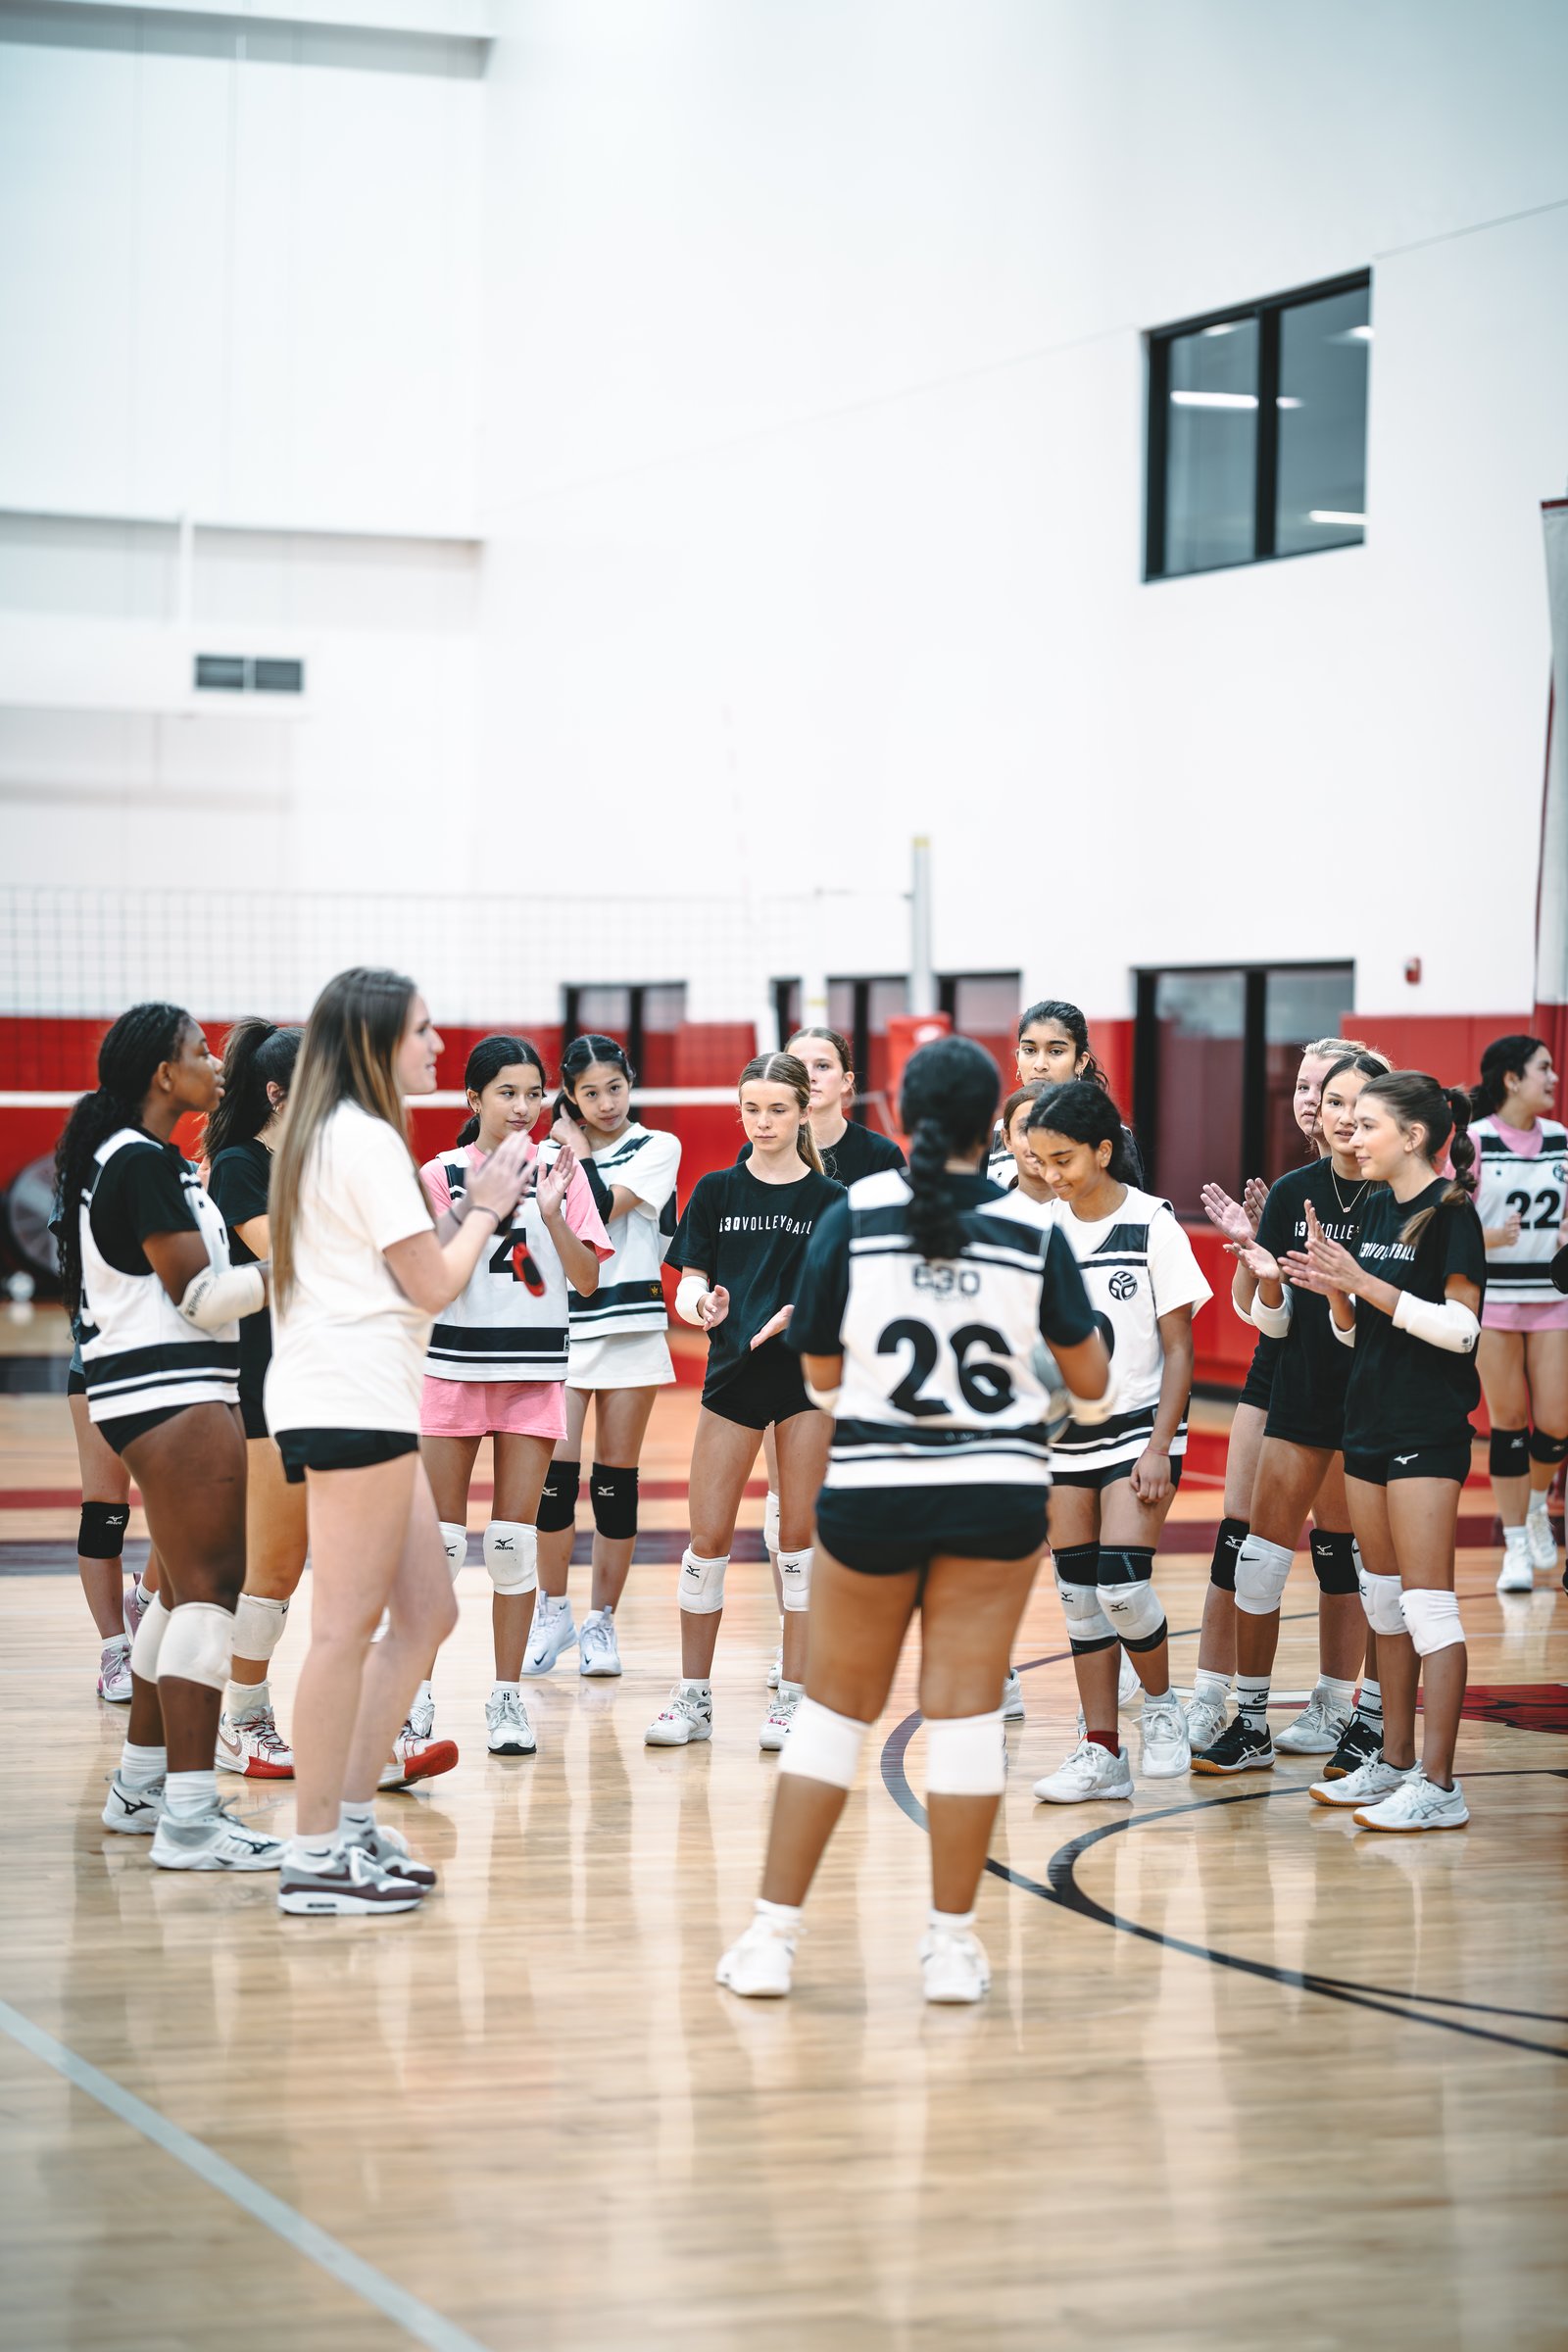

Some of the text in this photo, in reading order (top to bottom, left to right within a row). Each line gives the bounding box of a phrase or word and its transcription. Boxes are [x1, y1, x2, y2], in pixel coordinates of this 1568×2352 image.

[1506, 1191, 1560, 1229] 22
[489, 1228, 526, 1282] 4
[877, 1318, 1016, 1414] 26
